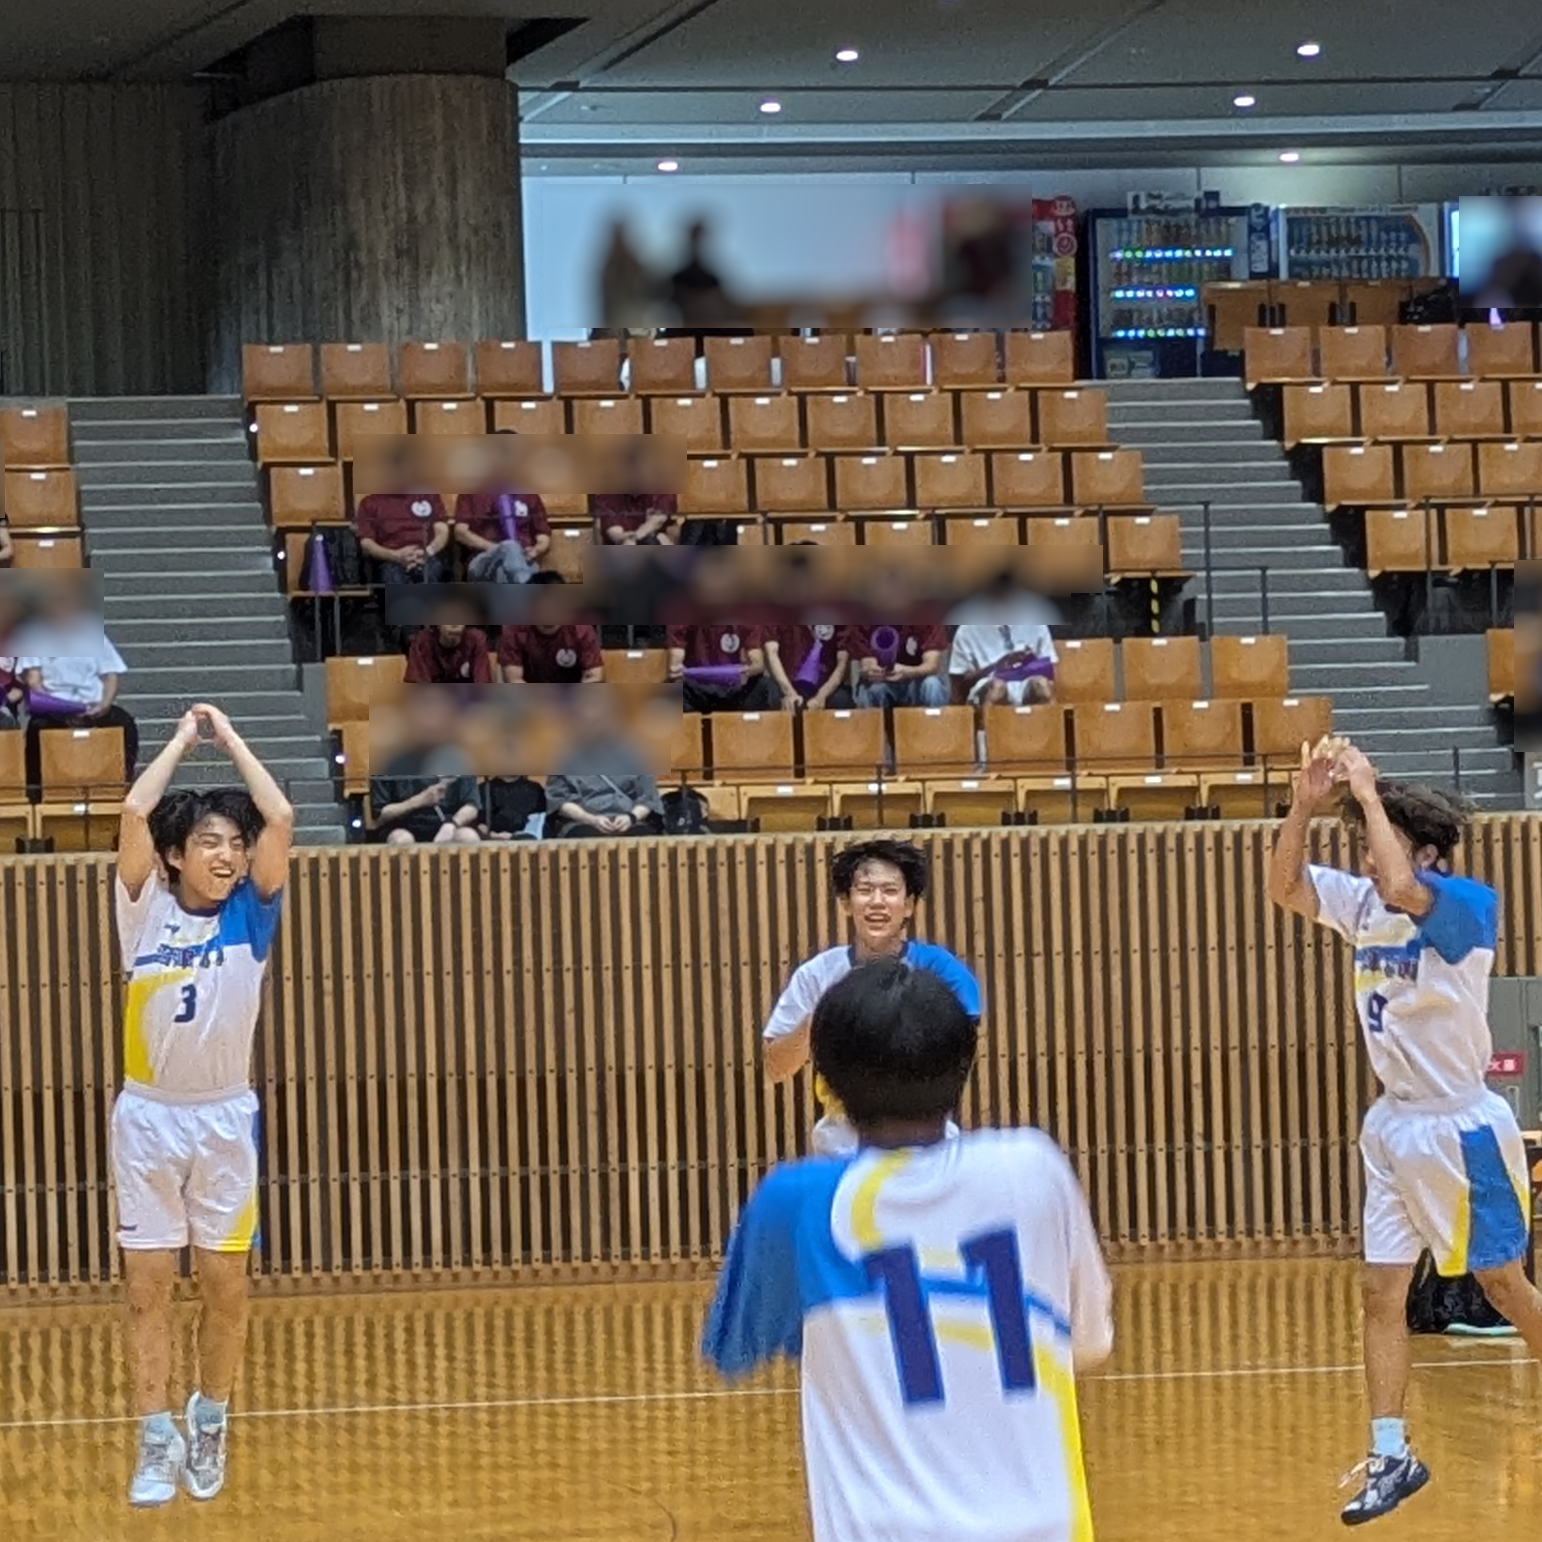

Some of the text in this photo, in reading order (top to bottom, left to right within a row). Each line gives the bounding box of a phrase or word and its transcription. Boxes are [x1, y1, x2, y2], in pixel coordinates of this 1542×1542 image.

[173, 983, 198, 1023] 3
[1366, 990, 1389, 1032] 9
[860, 1225, 1038, 1406] 11
